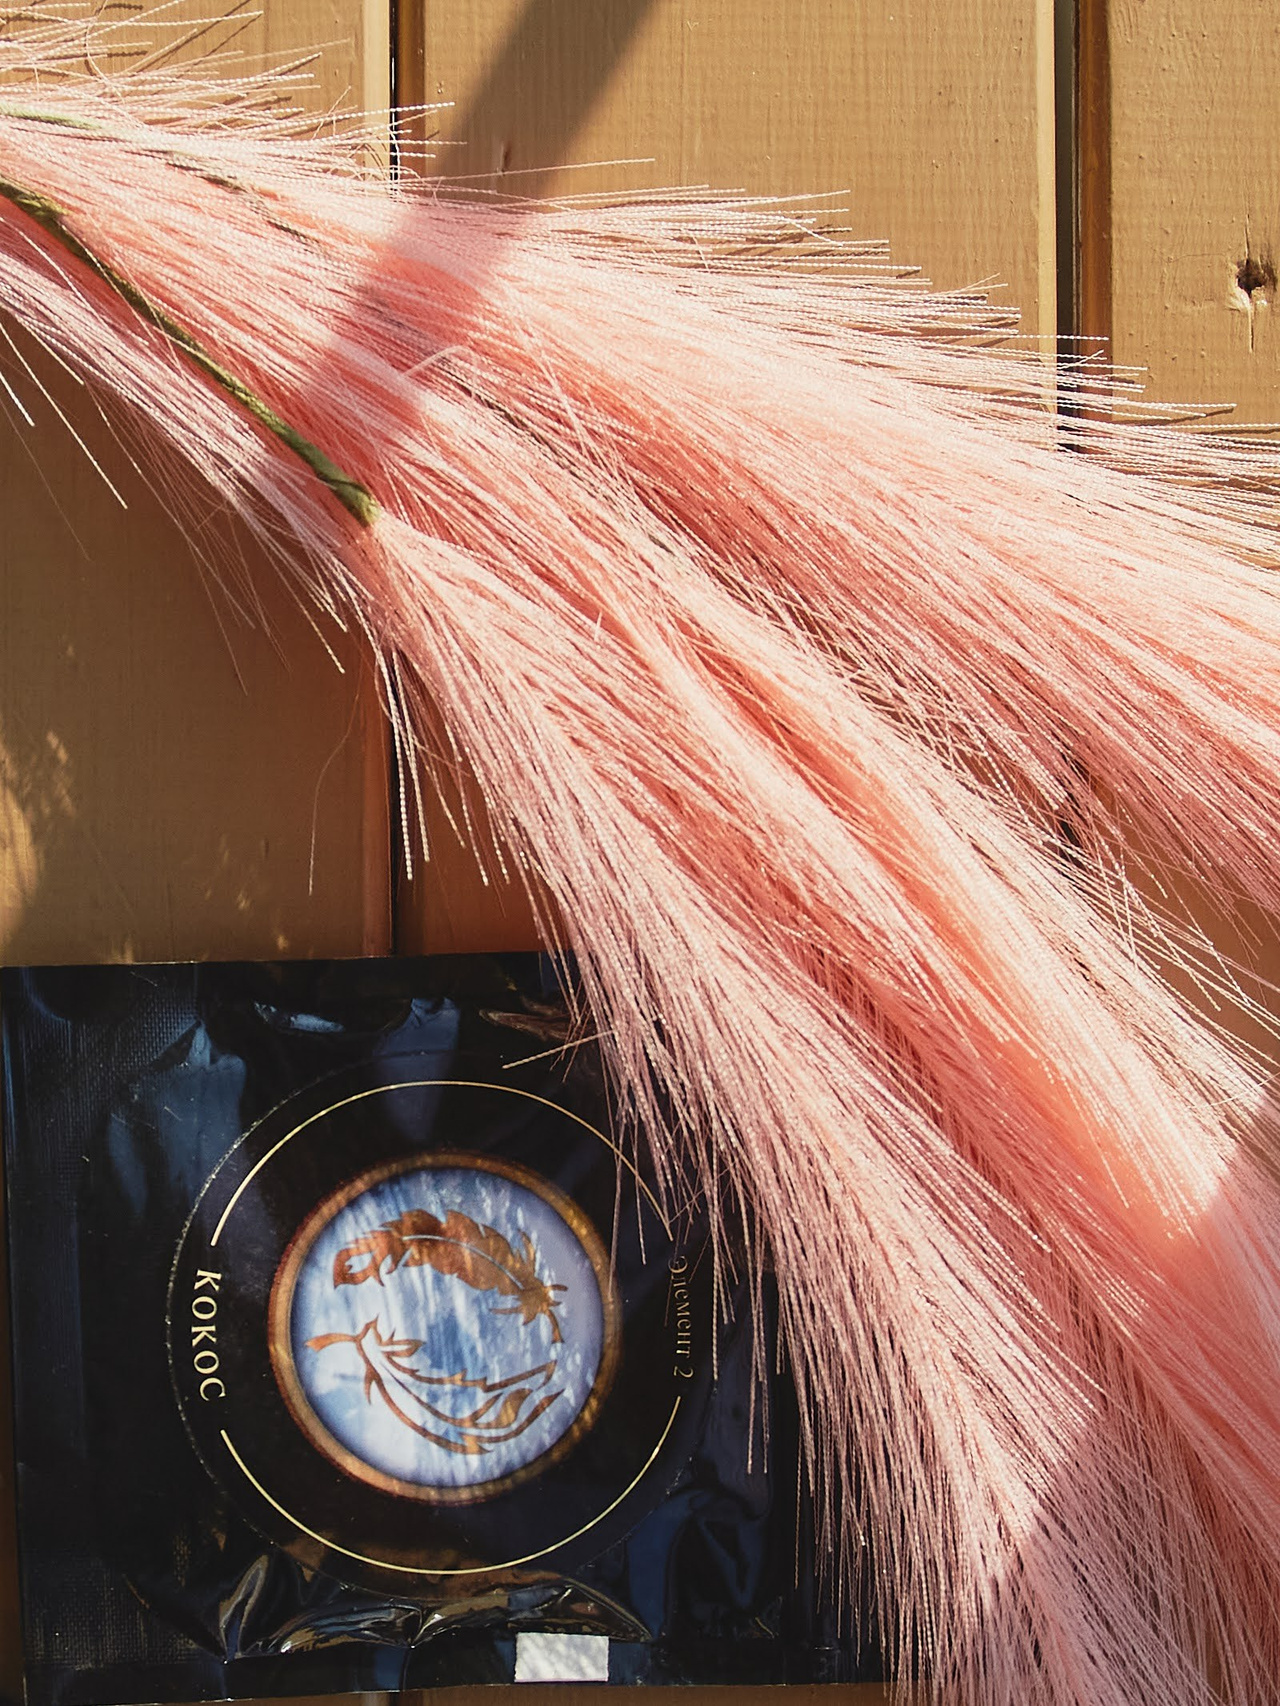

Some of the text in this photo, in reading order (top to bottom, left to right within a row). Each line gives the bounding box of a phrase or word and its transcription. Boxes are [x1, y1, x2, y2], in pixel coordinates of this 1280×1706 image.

[191, 1269, 226, 1401] КОКОС
[668, 1256, 694, 1379] Элемент 2
